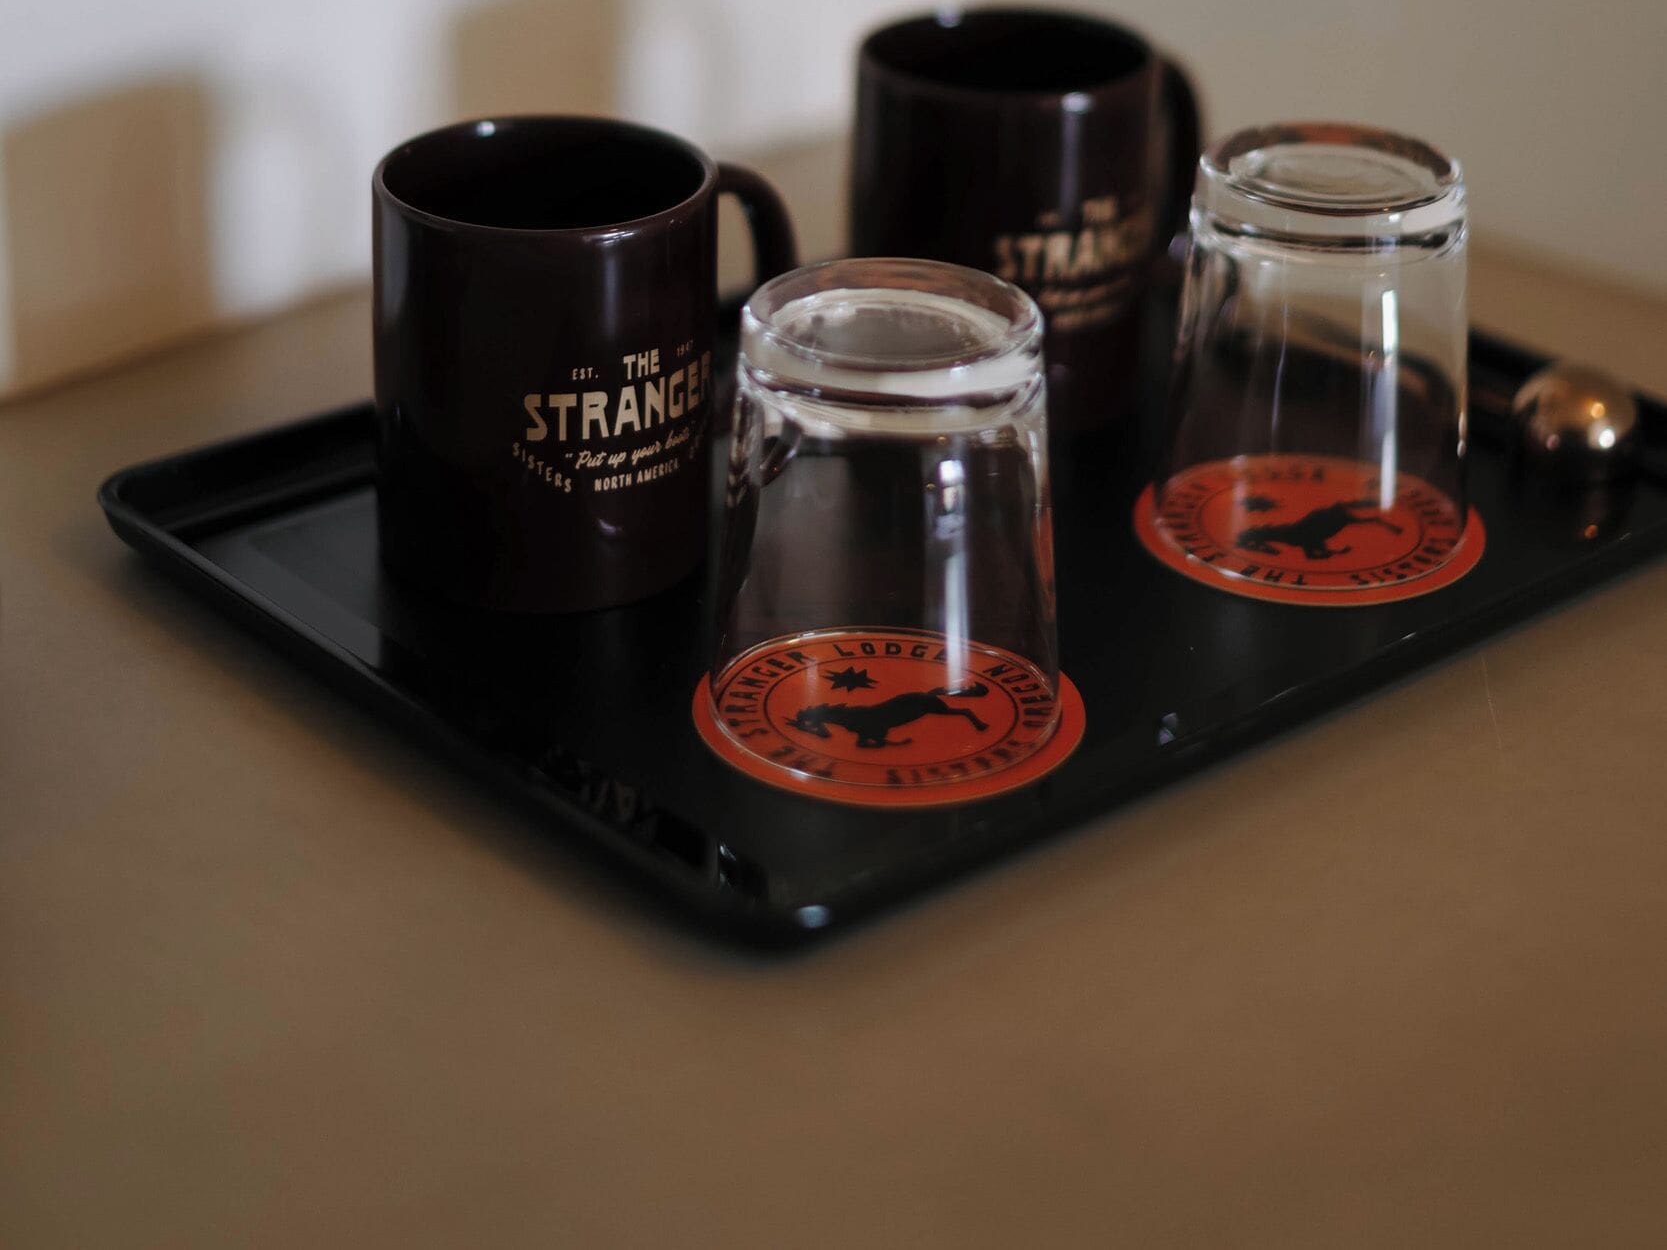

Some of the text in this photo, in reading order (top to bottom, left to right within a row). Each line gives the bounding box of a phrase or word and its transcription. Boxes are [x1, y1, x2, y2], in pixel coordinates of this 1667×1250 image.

[571, 366, 600, 382] EST.
[623, 348, 661, 381] THE
[512, 440, 573, 494] SISTERS
[607, 451, 627, 469] up
[631, 440, 661, 466] your
[594, 457, 679, 492] NORTH AMERICA
[723, 651, 814, 739] STRANGER
